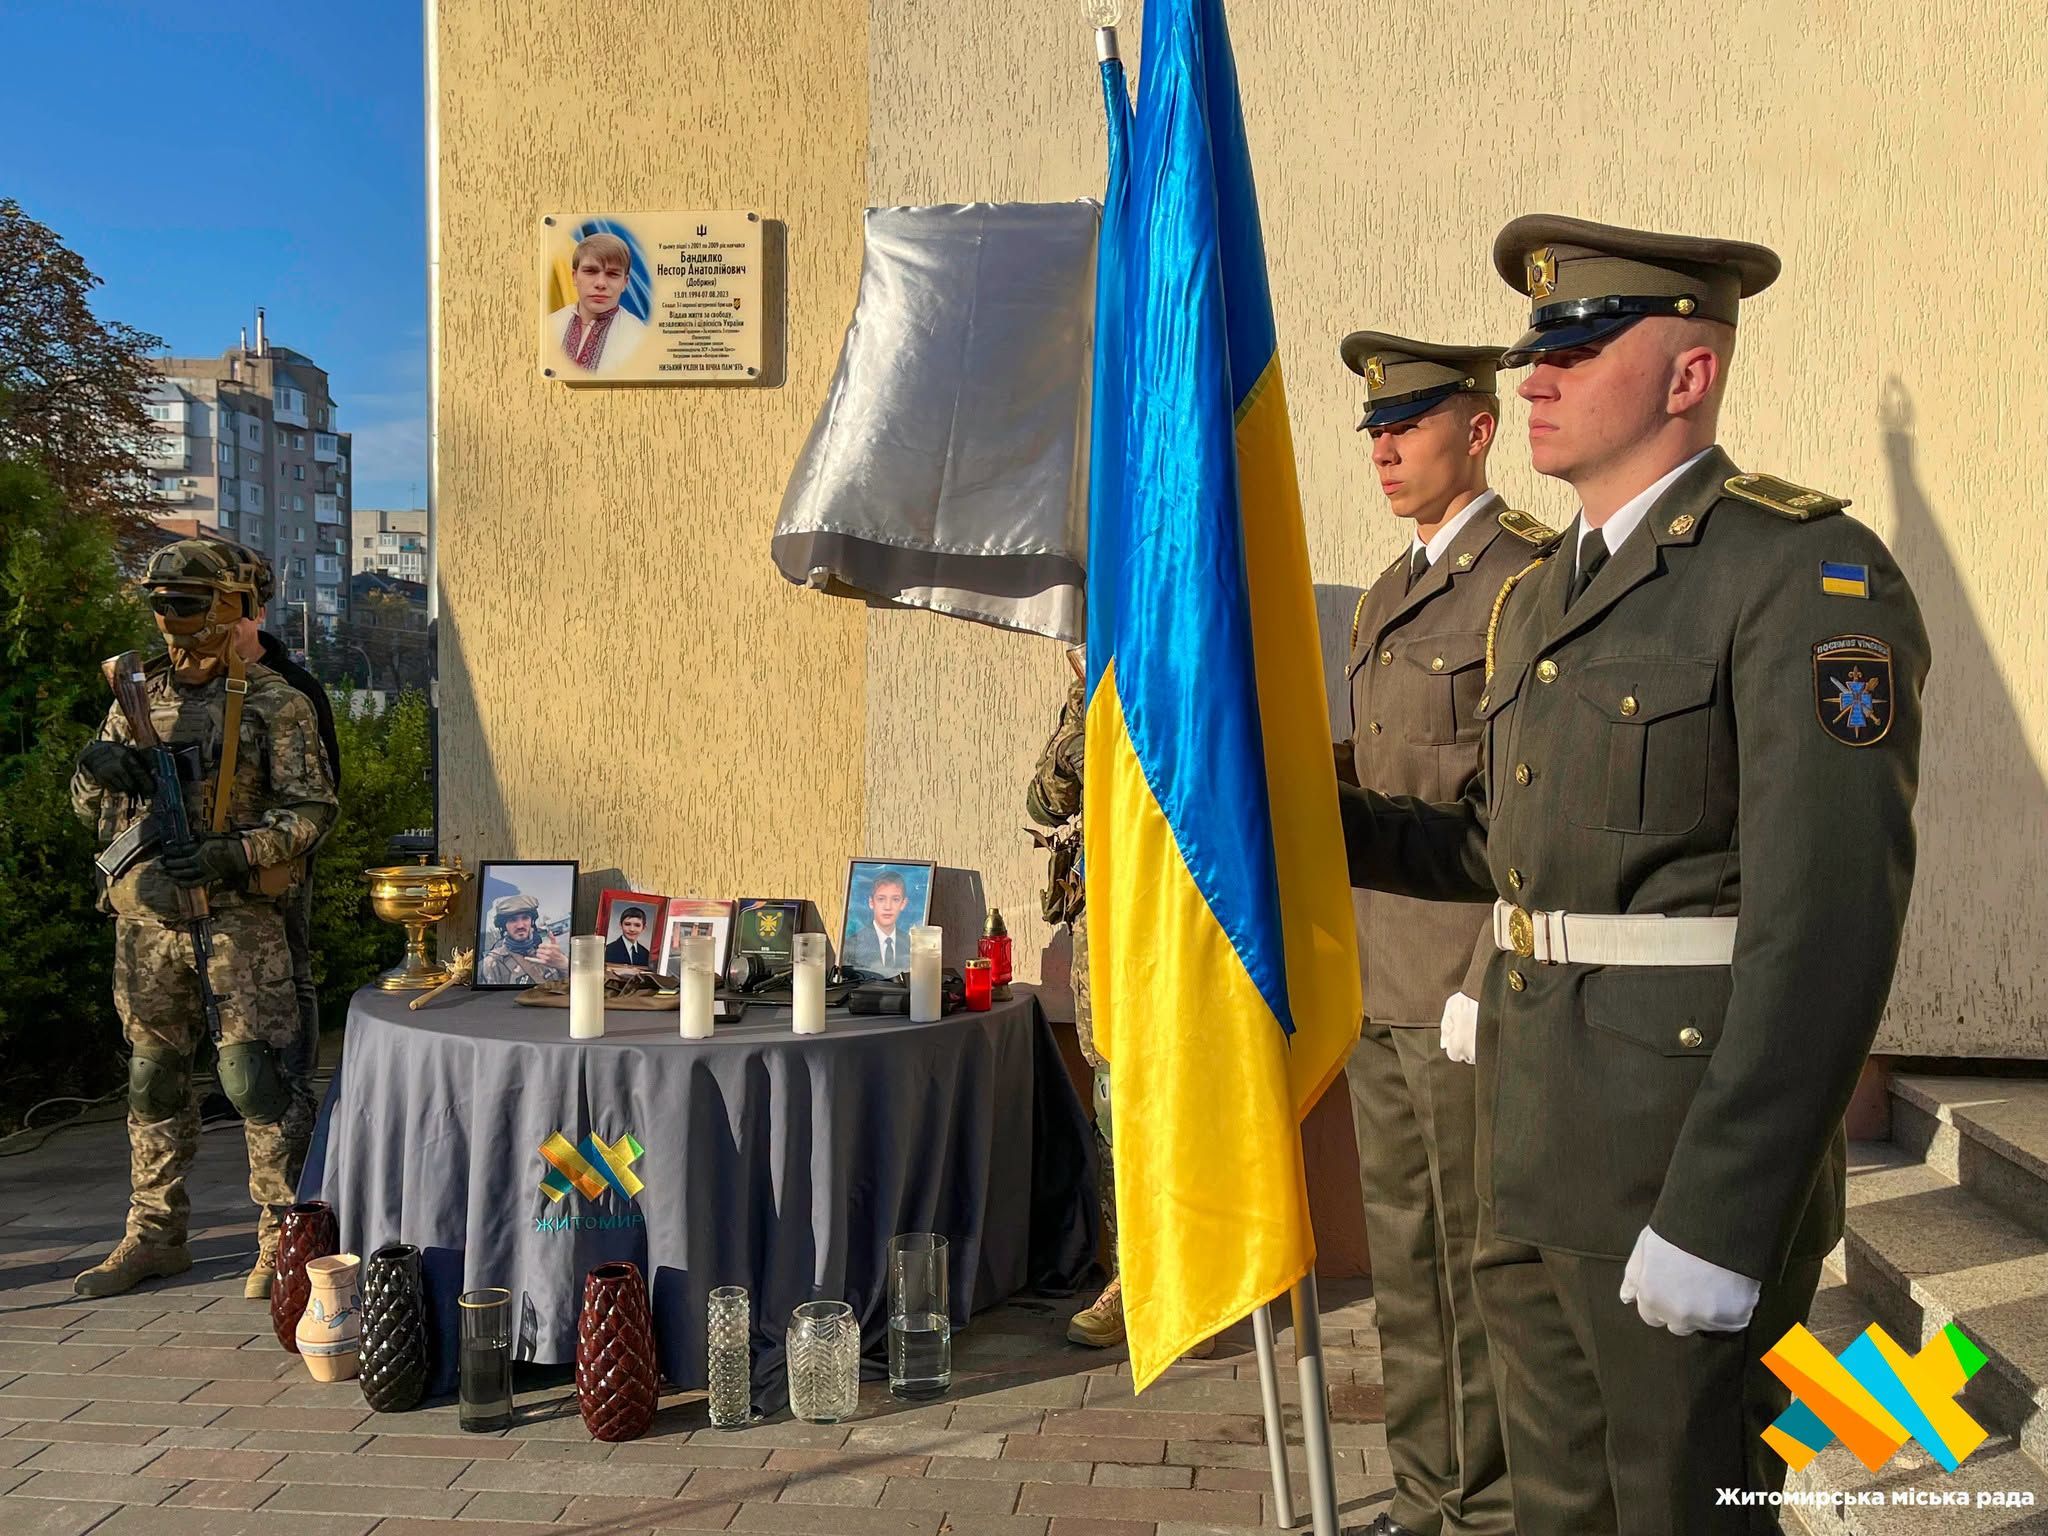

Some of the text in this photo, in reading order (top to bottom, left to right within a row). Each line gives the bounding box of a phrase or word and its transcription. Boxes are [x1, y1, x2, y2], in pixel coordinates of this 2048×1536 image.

[680, 251, 723, 263] Бандилко
[657, 263, 746, 277] Нестор Анатолійович
[535, 1216, 643, 1232] ЖИТОМИР
